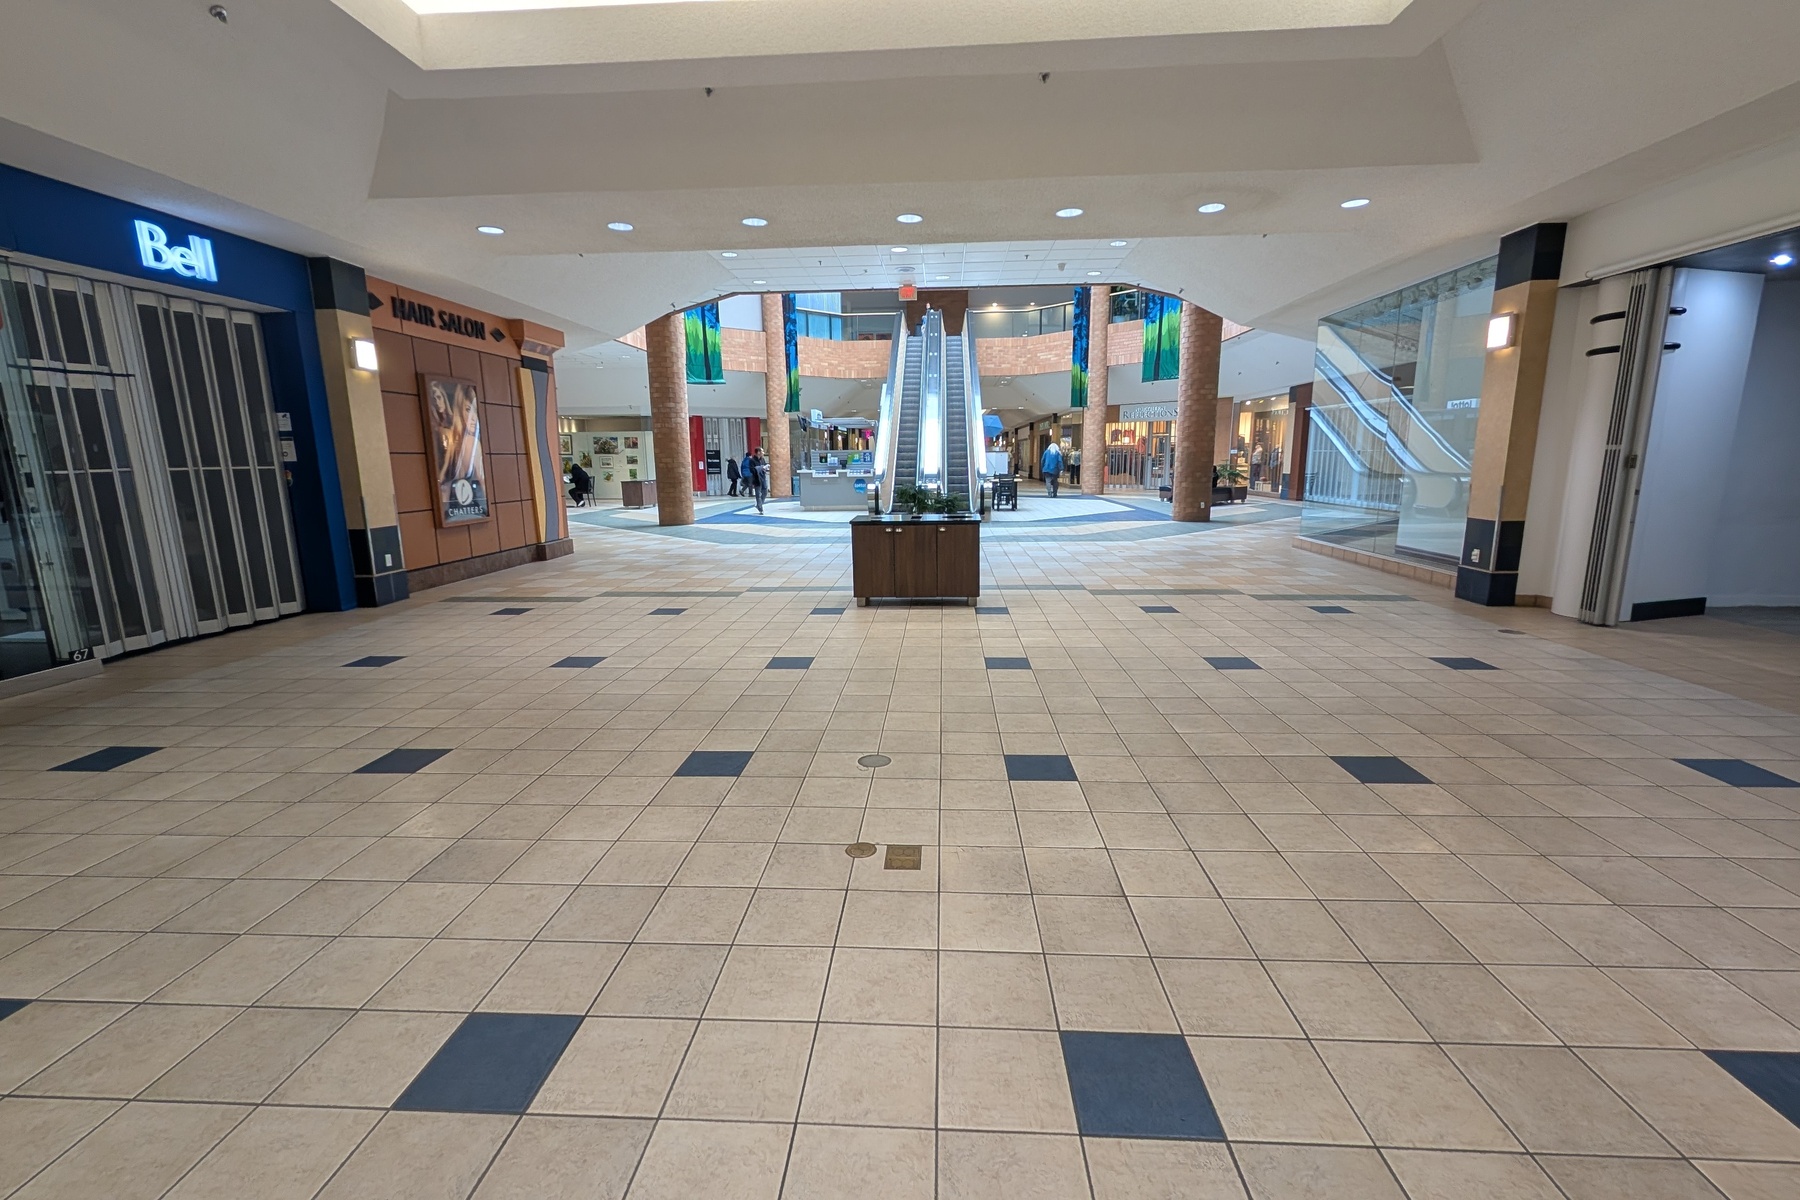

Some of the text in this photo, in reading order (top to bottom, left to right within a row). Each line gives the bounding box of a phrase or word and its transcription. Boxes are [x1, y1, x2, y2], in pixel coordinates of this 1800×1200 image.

[134, 219, 218, 282] Bell
[391, 296, 486, 340] HAIR SALON
[448, 505, 484, 517] CHATTERS
[73, 648, 88, 661] 67
